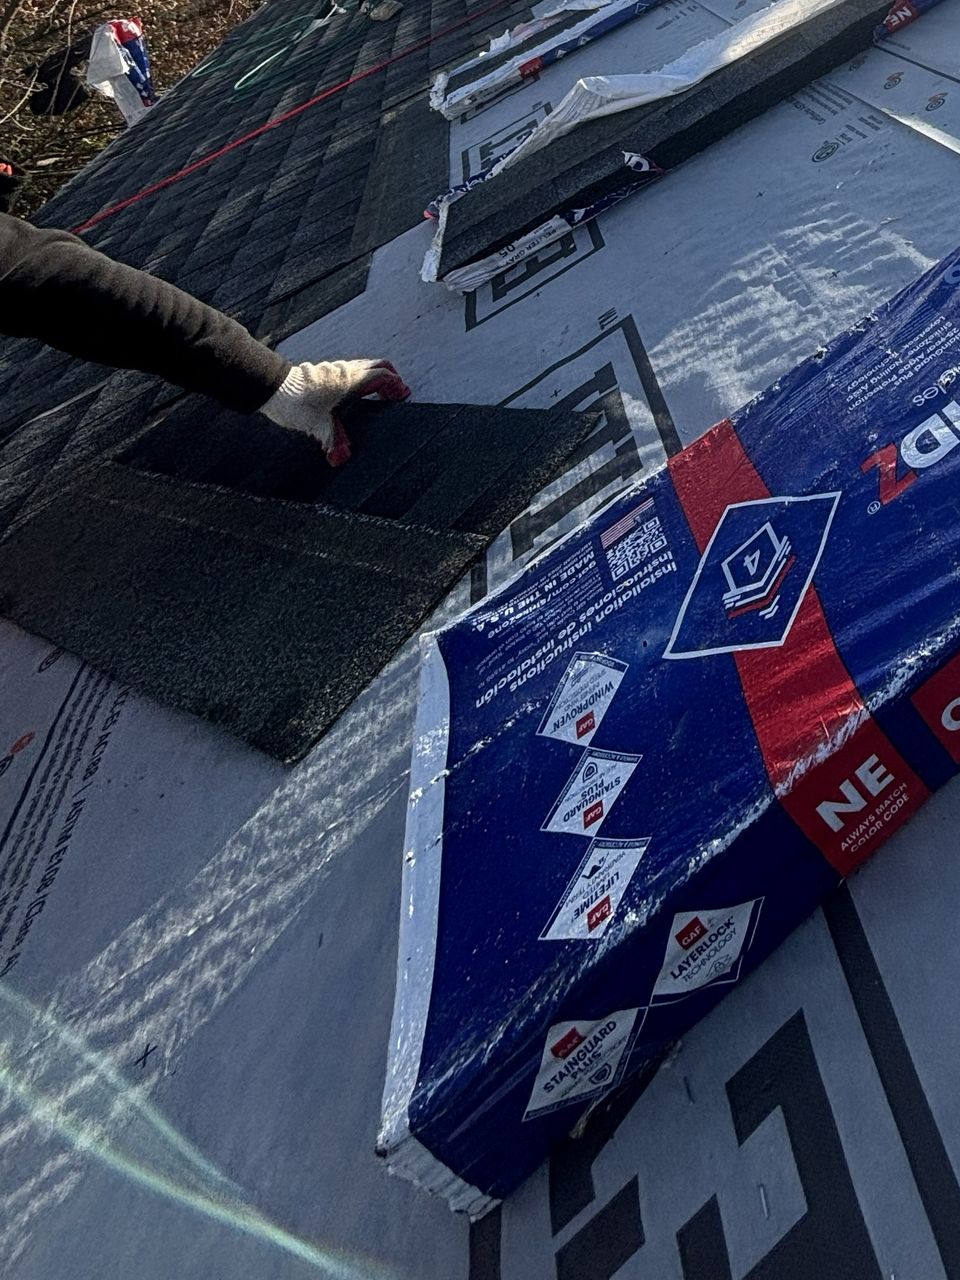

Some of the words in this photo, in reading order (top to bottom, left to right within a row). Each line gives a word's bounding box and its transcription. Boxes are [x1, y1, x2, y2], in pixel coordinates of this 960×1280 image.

[499, 243, 516, 259] 05
[544, 579, 558, 593] IN
[559, 550, 595, 582] MADE
[517, 590, 542, 610] THE
[594, 562, 678, 624] Installation
[474, 638, 556, 710] instalación
[508, 620, 594, 694] instructions
[552, 680, 615, 734] WINDPROVEN
[577, 716, 596, 734] GAF
[562, 776, 622, 823] STAINGUARD
[580, 778, 604, 800] PLUS
[815, 753, 895, 832] NE
[584, 805, 603, 824] GAF
[840, 813, 876, 852] ALWAYS
[875, 782, 908, 817] MATCH
[850, 819, 885, 852] COLOR
[882, 792, 910, 822] CODE
[589, 903, 610, 923] GAF
[681, 924, 702, 947] GAF
[681, 928, 738, 983] TECHNOLOGY
[542, 1019, 618, 1094] STAINGUARD
